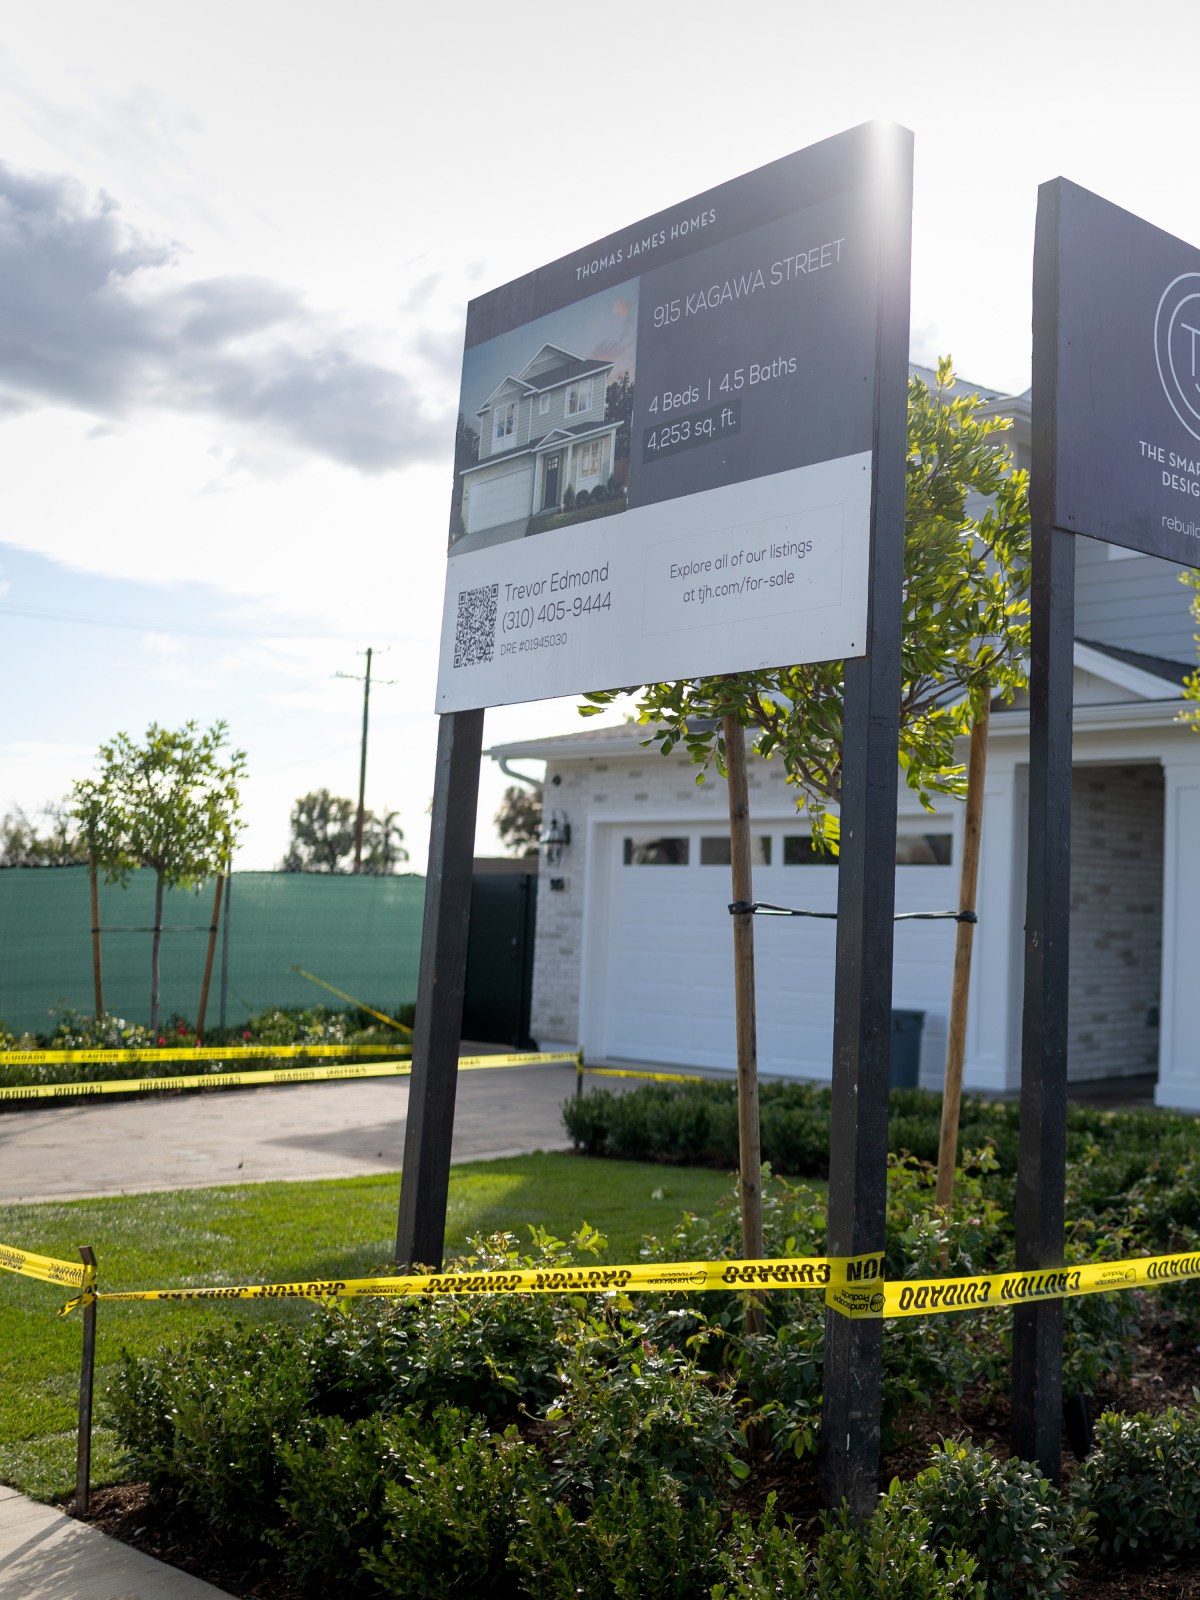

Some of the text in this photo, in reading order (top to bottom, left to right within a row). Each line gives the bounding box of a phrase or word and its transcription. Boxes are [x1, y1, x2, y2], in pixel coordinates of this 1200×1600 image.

[576, 208, 716, 281] THOMAS JAMES HOMES
[653, 237, 846, 328] 915 KAGAWA STREET
[648, 395, 659, 414] 4
[662, 385, 700, 412] Beds
[719, 368, 745, 393] 4.5
[749, 356, 797, 385] Baths
[647, 408, 736, 451] 4,253 sq. ft.
[1139, 440, 1165, 463] THE
[670, 540, 813, 581] Explore all of our listings
[505, 561, 609, 602] Trevor Edmond
[683, 570, 795, 604] at tjh.com/for-sale
[502, 591, 611, 633] (310) 405-9444
[500, 641, 517, 656] DRE
[253, 1282, 346, 1298] CAUTION
[422, 1270, 632, 1293] CAUTION CUIDADO
[721, 1263, 832, 1283] CUIDADO
[899, 1271, 1081, 1311] CAUTION CUIDADO
[833, 1295, 868, 1312] Landscape
[841, 1289, 870, 1303] Products
